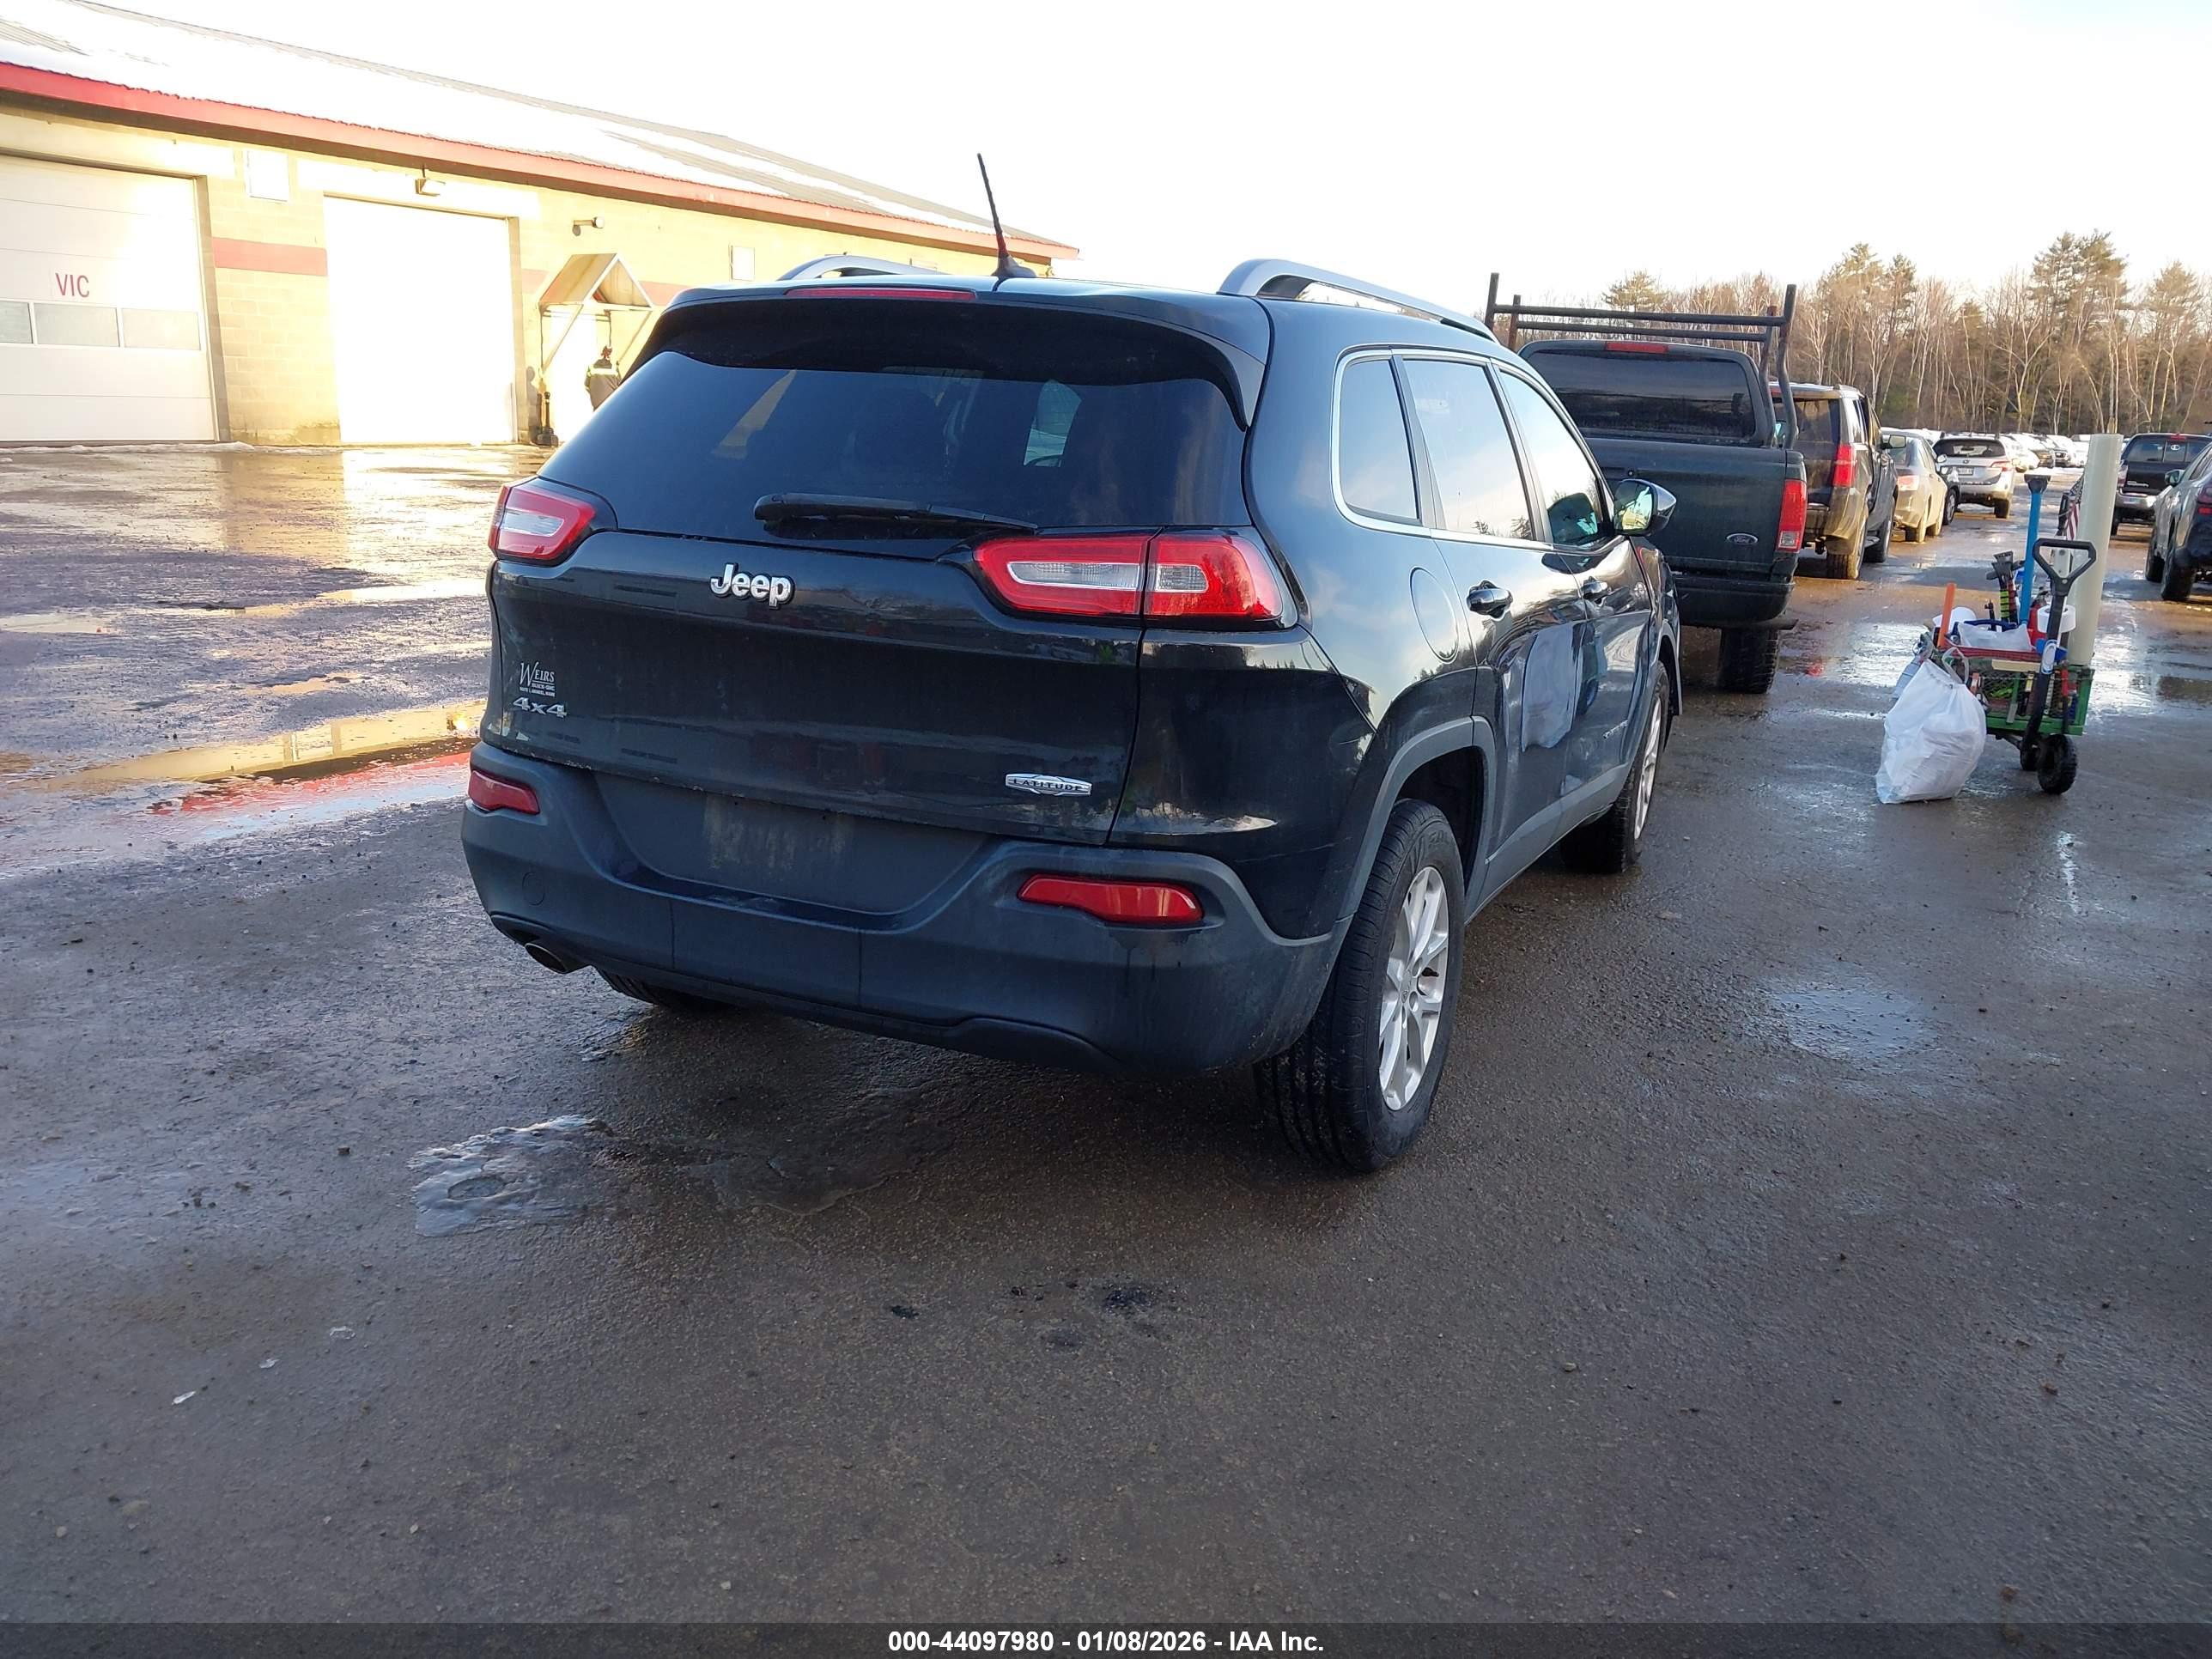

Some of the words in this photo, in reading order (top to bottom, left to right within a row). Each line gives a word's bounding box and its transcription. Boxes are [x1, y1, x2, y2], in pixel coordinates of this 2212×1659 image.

[55, 272, 89, 297] VIC
[710, 563, 792, 606] Jeep
[1012, 778, 1082, 791] LATITUDE
